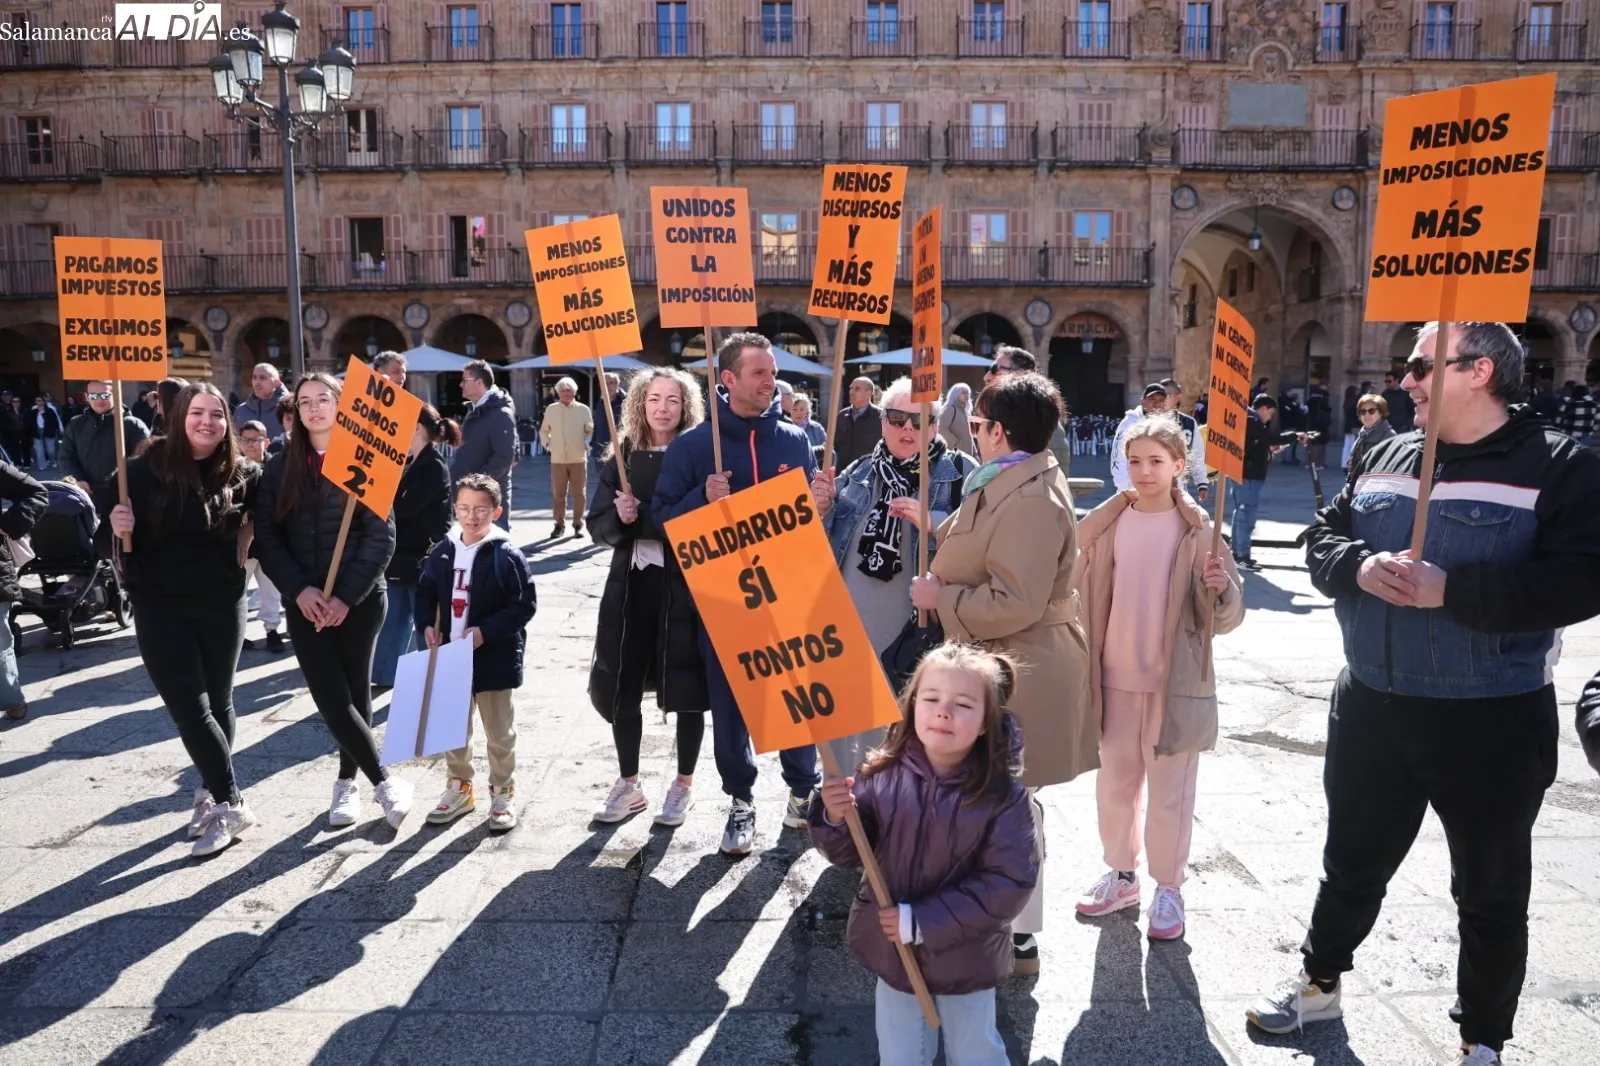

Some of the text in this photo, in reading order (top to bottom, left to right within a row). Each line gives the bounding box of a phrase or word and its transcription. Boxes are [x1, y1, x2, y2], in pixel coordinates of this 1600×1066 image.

[1410, 113, 1510, 150] MENOS
[1383, 150, 1544, 185] IMPOSICIONES
[833, 172, 892, 193] MENOS
[663, 198, 735, 217] UNIDOS
[823, 199, 901, 219] DISCURSOS
[1412, 200, 1483, 239] MÁS
[547, 236, 602, 260] MENOS
[666, 227, 736, 244] CONTRA
[848, 224, 860, 249] Y
[65, 256, 157, 274] PAGAMOS
[535, 256, 625, 282] IMPOSICIONES
[691, 255, 717, 272] LA
[828, 254, 873, 286] MÁS
[1372, 247, 1531, 278] SOLUCIONES
[62, 279, 161, 296] IMPUESTOS
[563, 287, 604, 312] MÁS
[661, 284, 754, 303] IMPOSICIÓN
[812, 288, 889, 314] RECURSOS
[65, 318, 161, 336] EXIGIMOS
[545, 308, 635, 339] SOLUCIONES
[1218, 317, 1226, 337] NI
[66, 345, 163, 362] SERVICIOS
[1216, 344, 1224, 362] NI
[365, 374, 395, 407] NO
[1211, 375, 1216, 389] A
[1218, 380, 1226, 395] LA
[352, 398, 398, 436] SOMOS
[1224, 408, 1236, 430] LOS
[336, 411, 406, 466] CIUDADANOS
[354, 445, 375, 468] DE
[676, 493, 814, 570] SOLIDARIOS
[738, 554, 778, 610] SÍ
[737, 624, 844, 681] TONTOS
[781, 682, 835, 724] NO
